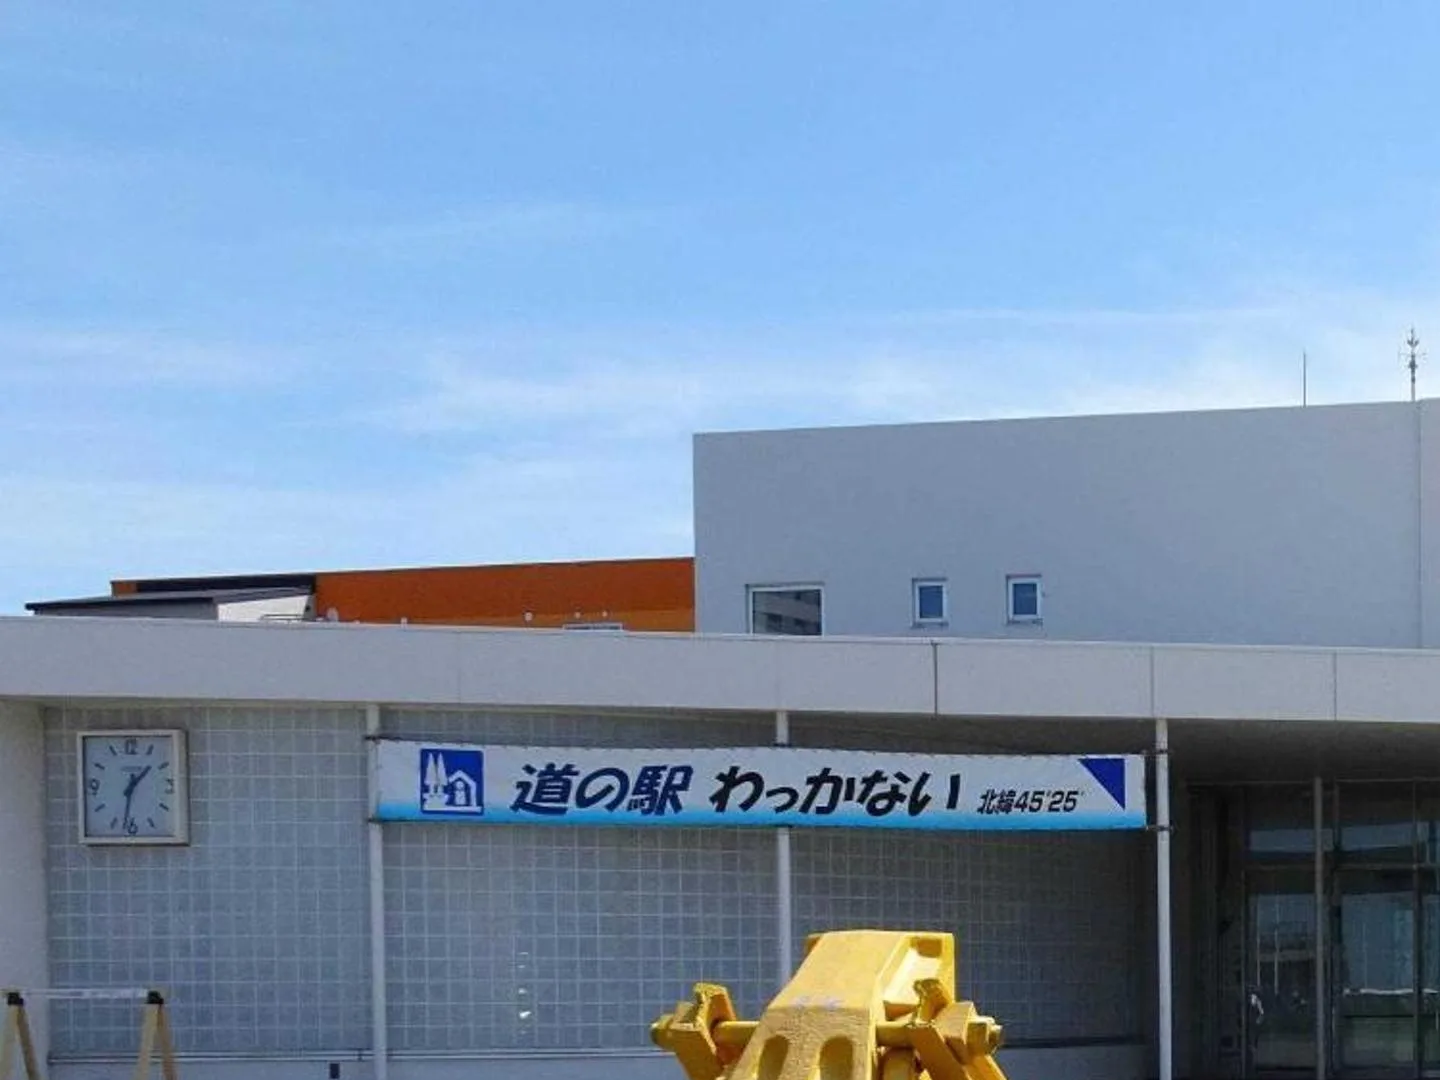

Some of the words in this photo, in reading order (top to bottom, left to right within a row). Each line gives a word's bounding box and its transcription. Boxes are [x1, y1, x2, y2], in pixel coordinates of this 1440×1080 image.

[509, 762, 694, 816] 道の駅
[708, 765, 961, 817] わっかない
